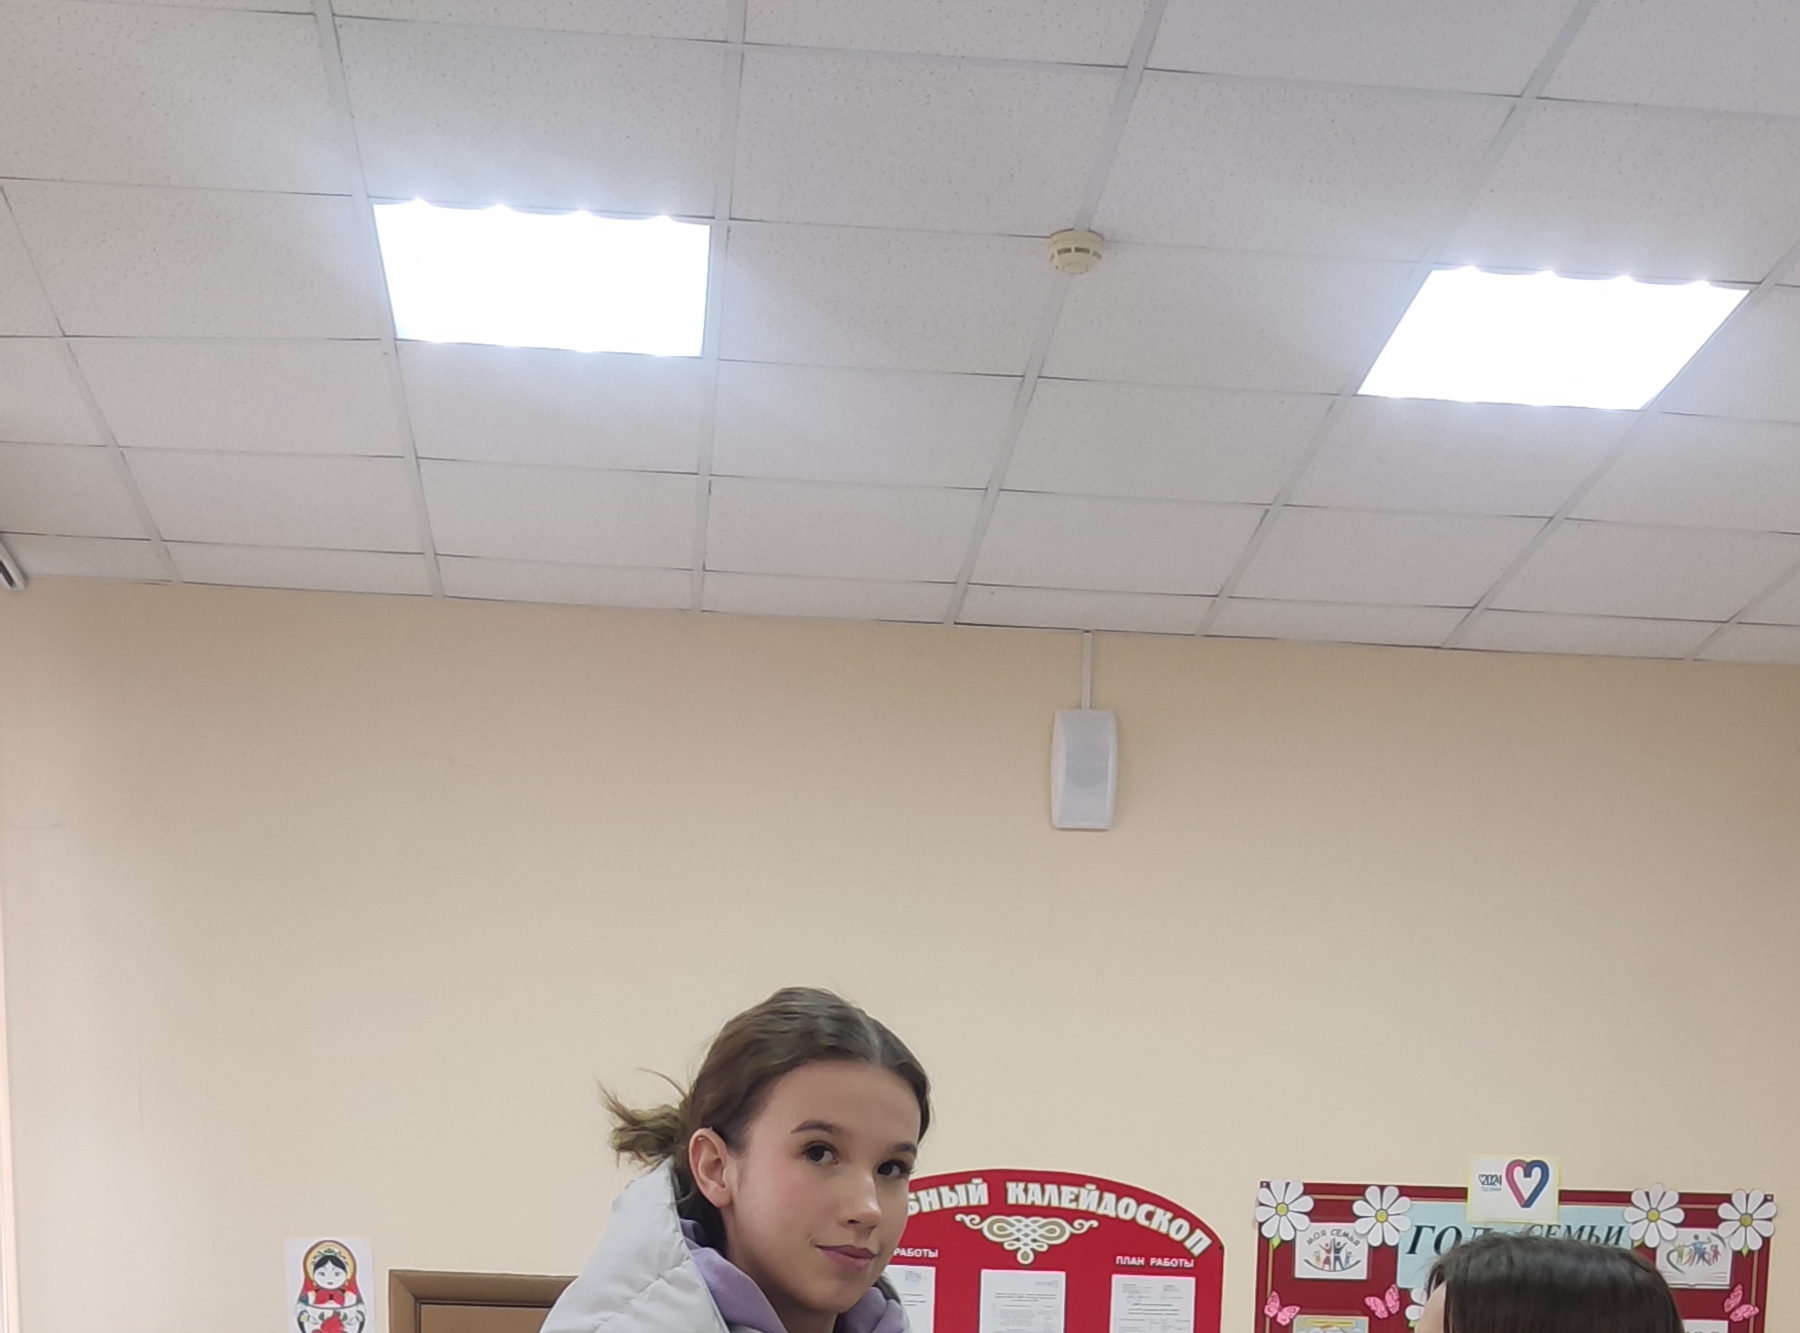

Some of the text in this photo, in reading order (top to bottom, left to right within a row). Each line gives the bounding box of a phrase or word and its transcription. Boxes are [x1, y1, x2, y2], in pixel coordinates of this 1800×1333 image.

[1006, 1181, 1213, 1257] КАЛЕЙДОСКОП
[893, 1247, 939, 1258] РАБОТЫ
[1115, 1255, 1195, 1268] ПЛАН РАБОТЫ
